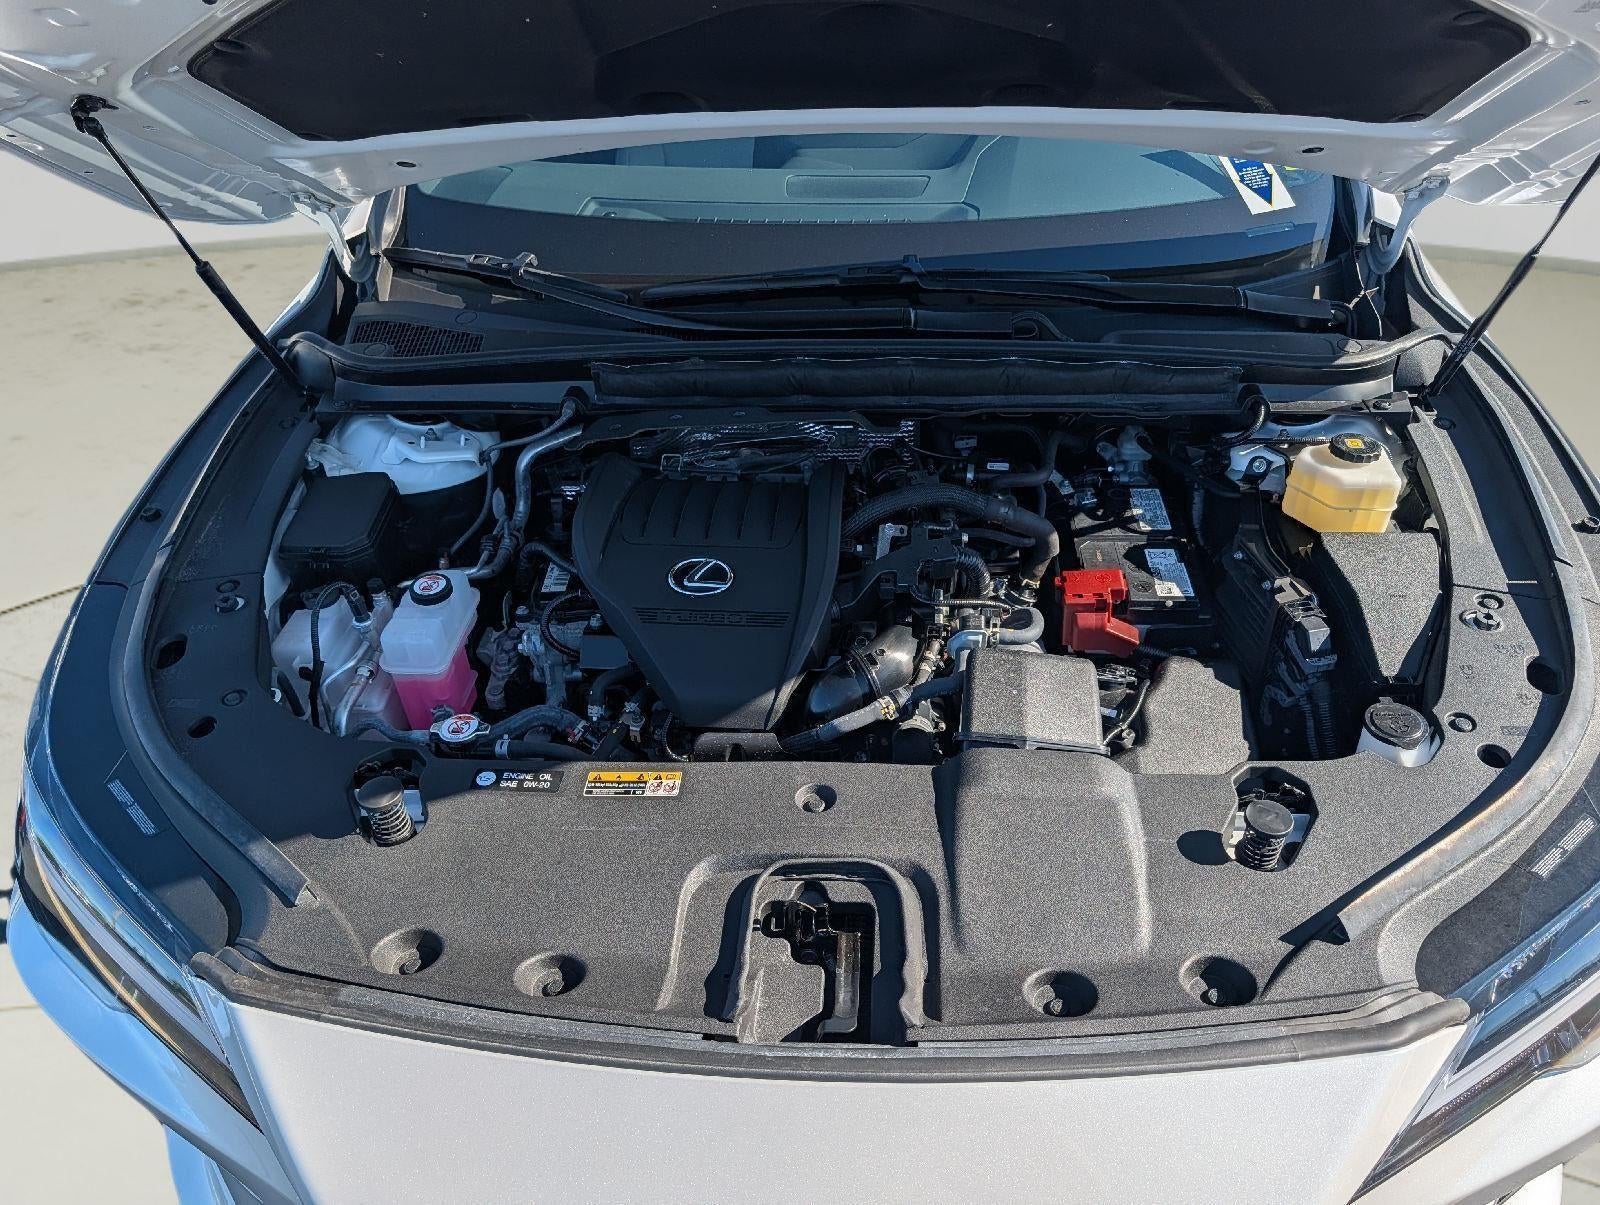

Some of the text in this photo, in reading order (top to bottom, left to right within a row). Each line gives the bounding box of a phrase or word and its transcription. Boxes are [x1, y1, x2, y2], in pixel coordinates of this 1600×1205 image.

[502, 772, 553, 781] ENGINE OIL
[500, 780, 551, 789] SAE 0W-20
